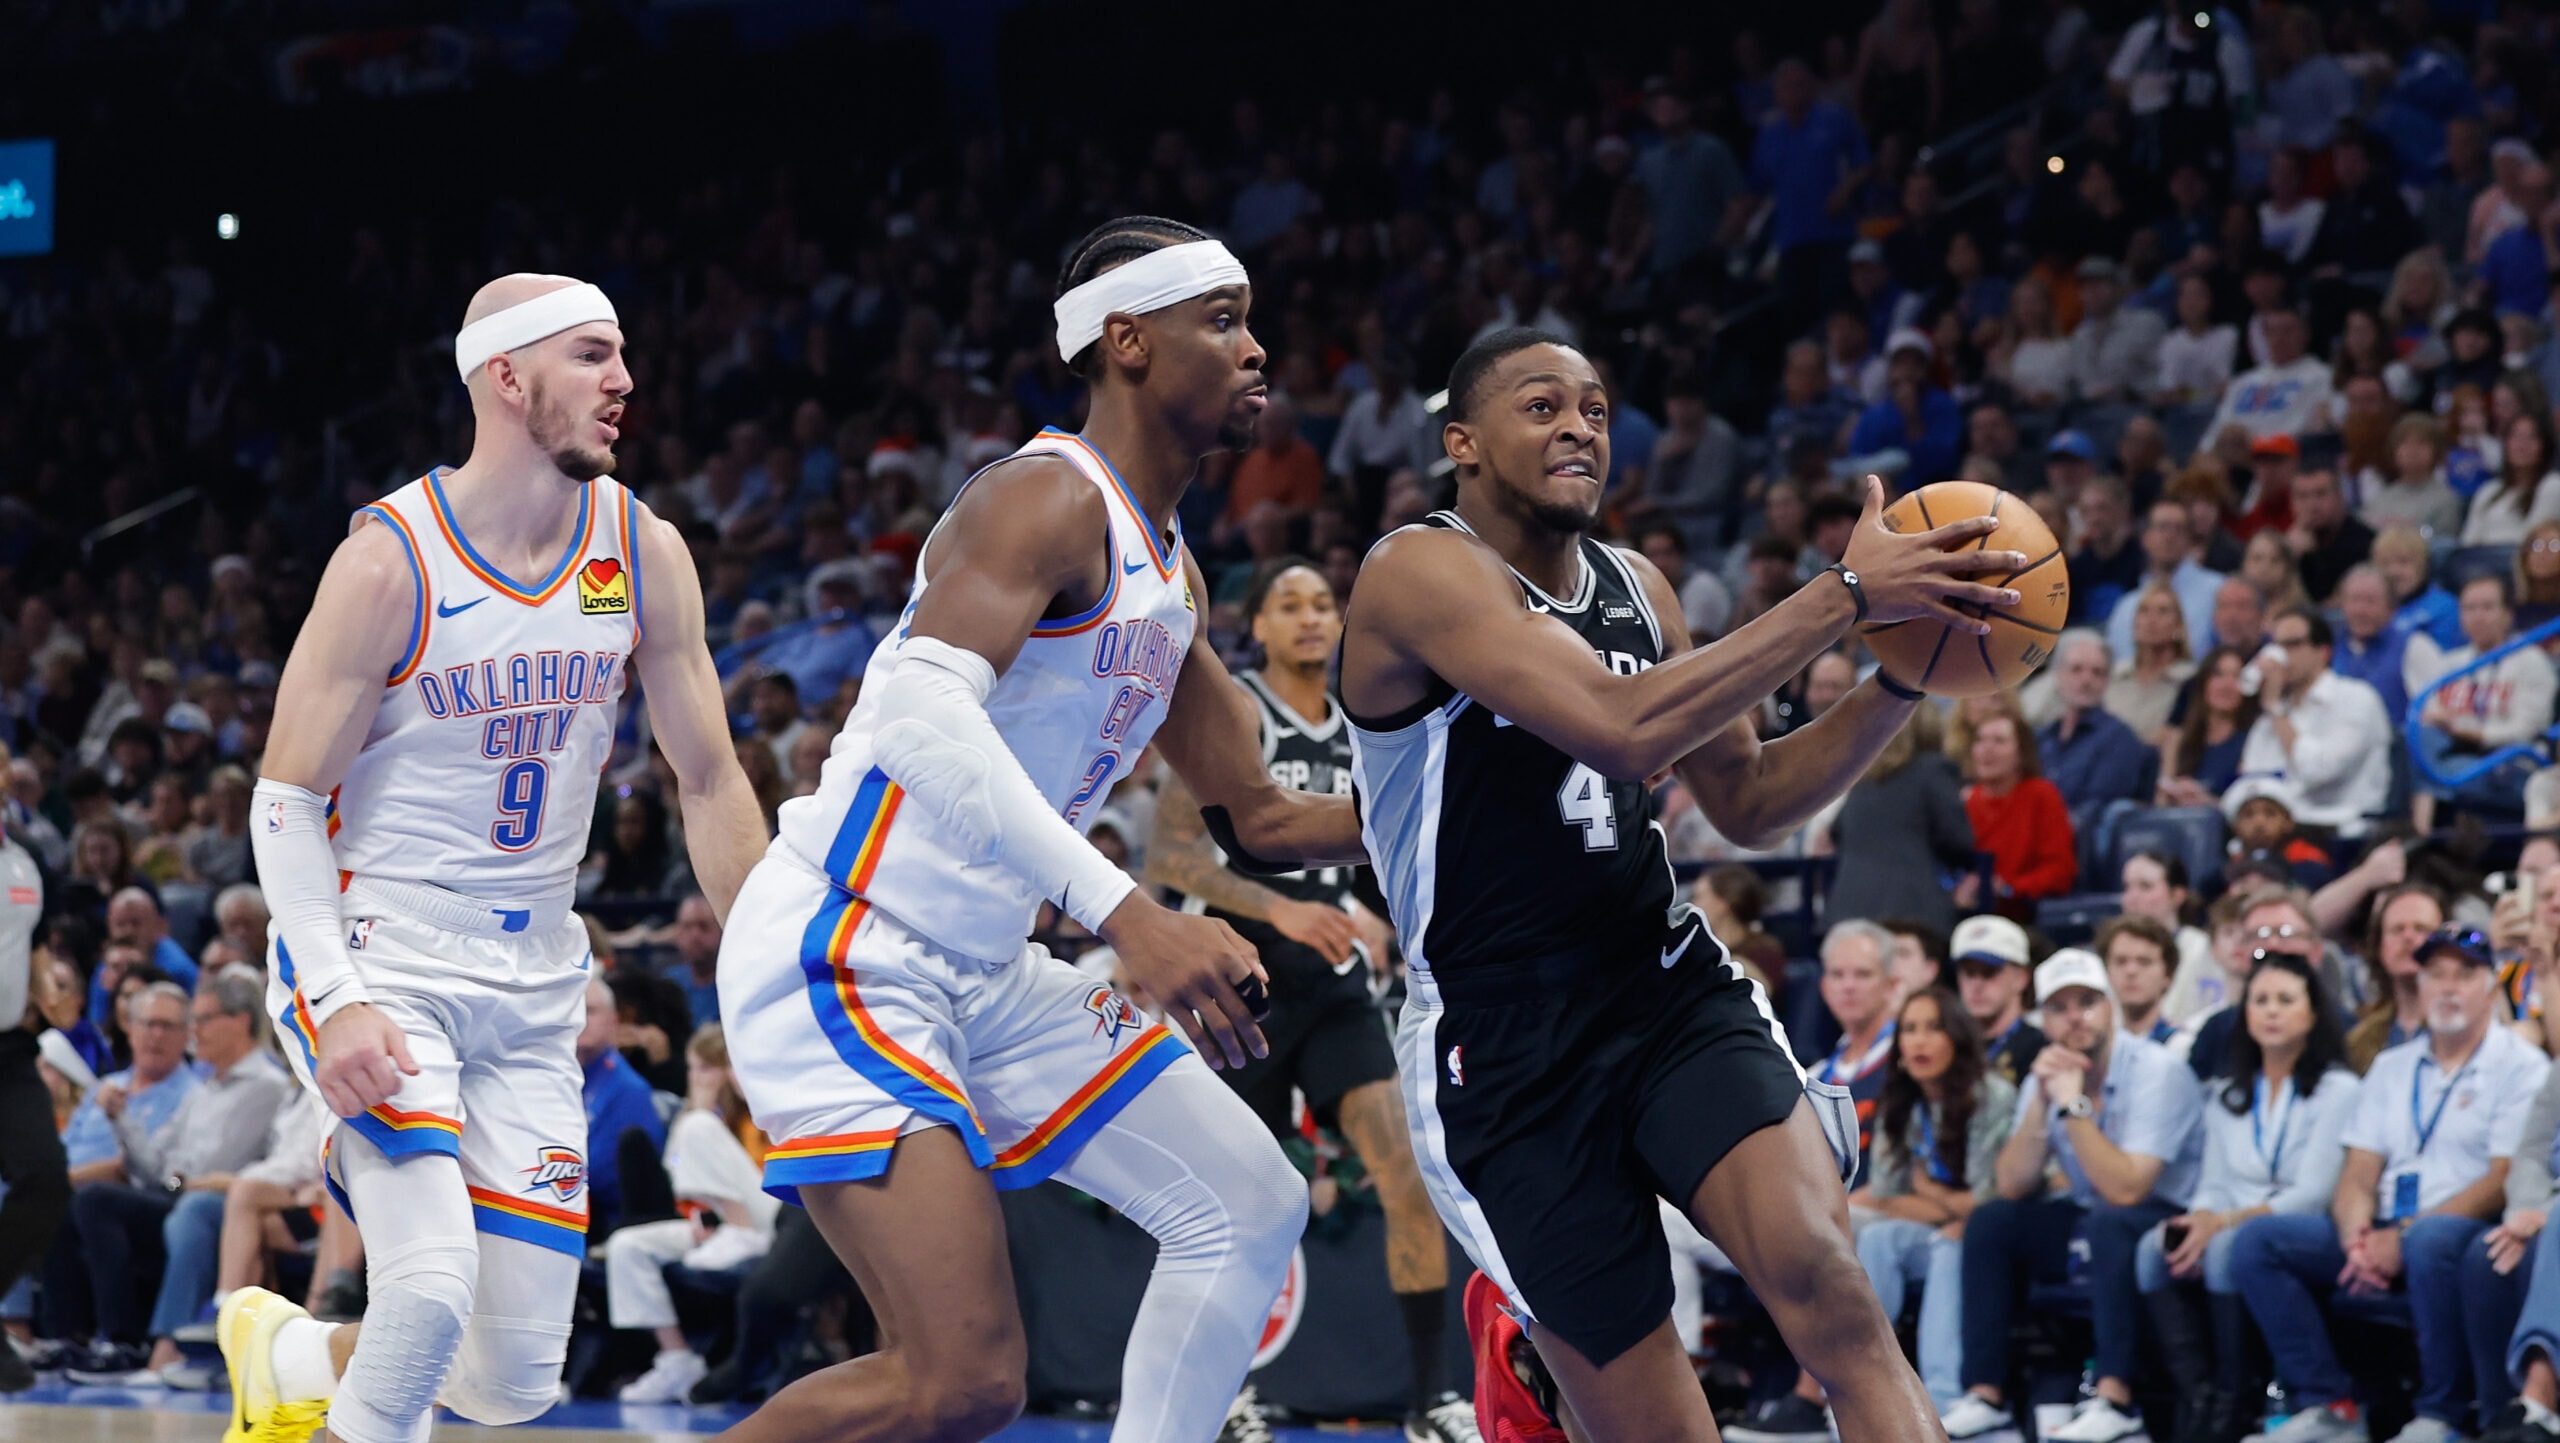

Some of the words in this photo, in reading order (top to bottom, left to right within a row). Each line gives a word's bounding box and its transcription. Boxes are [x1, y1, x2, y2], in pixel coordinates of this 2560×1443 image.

[1605, 607, 1636, 619] LEDGER
[416, 650, 619, 720] OKLAHOM
[481, 706, 579, 759] CITY
[490, 757, 549, 852] 9
[1063, 750, 1120, 826] 2
[1557, 760, 1619, 852] 4
